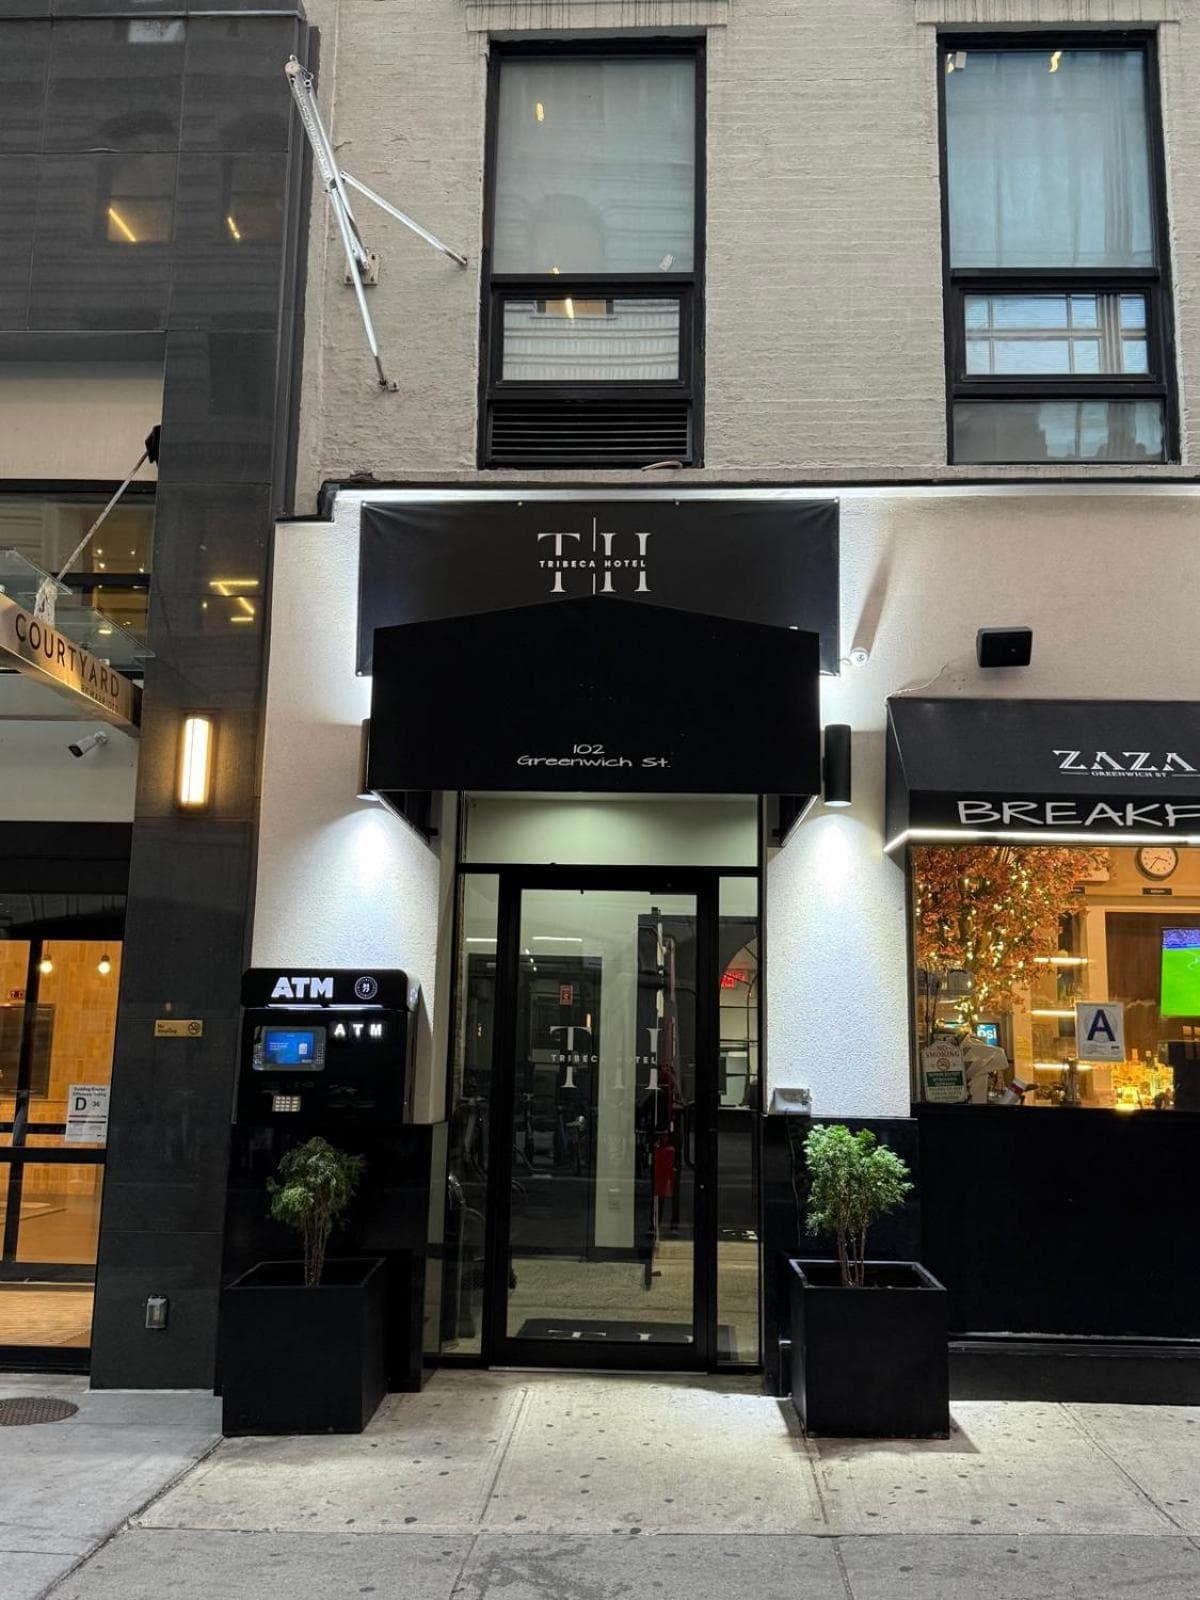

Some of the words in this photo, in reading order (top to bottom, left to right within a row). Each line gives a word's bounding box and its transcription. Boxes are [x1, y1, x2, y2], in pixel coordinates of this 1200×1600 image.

[539, 560, 596, 568] TRIBECA
[604, 559, 646, 568] HOTEL
[15, 613, 120, 698] COURTYARD
[573, 744, 605, 754] 102
[516, 755, 633, 767] Greenwich
[641, 757, 672, 767] St.
[1052, 750, 1198, 771] ZAZA
[957, 801, 1200, 827] BREAKF
[271, 977, 334, 998] ATM
[334, 1023, 383, 1036] ATM
[1087, 1009, 1116, 1042] A
[551, 1054, 606, 1063] TRIBEC
[75, 1097, 87, 1111] D
